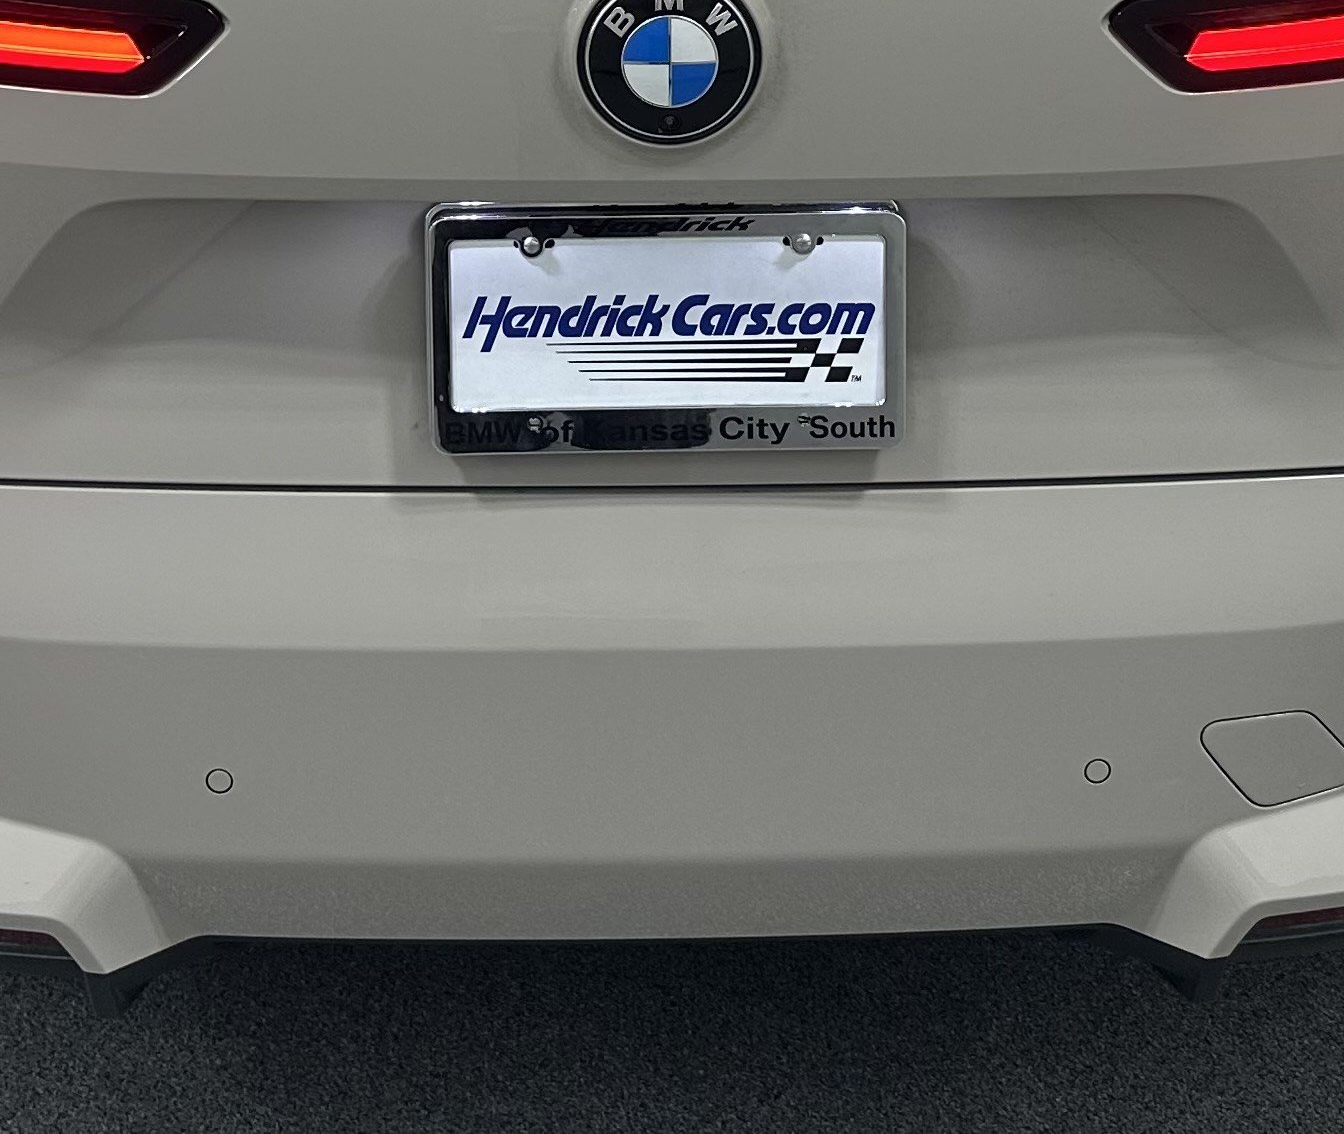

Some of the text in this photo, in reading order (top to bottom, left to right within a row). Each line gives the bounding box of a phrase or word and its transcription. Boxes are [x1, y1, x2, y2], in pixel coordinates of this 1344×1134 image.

[445, 414, 895, 445] BMW of Kansas City South
